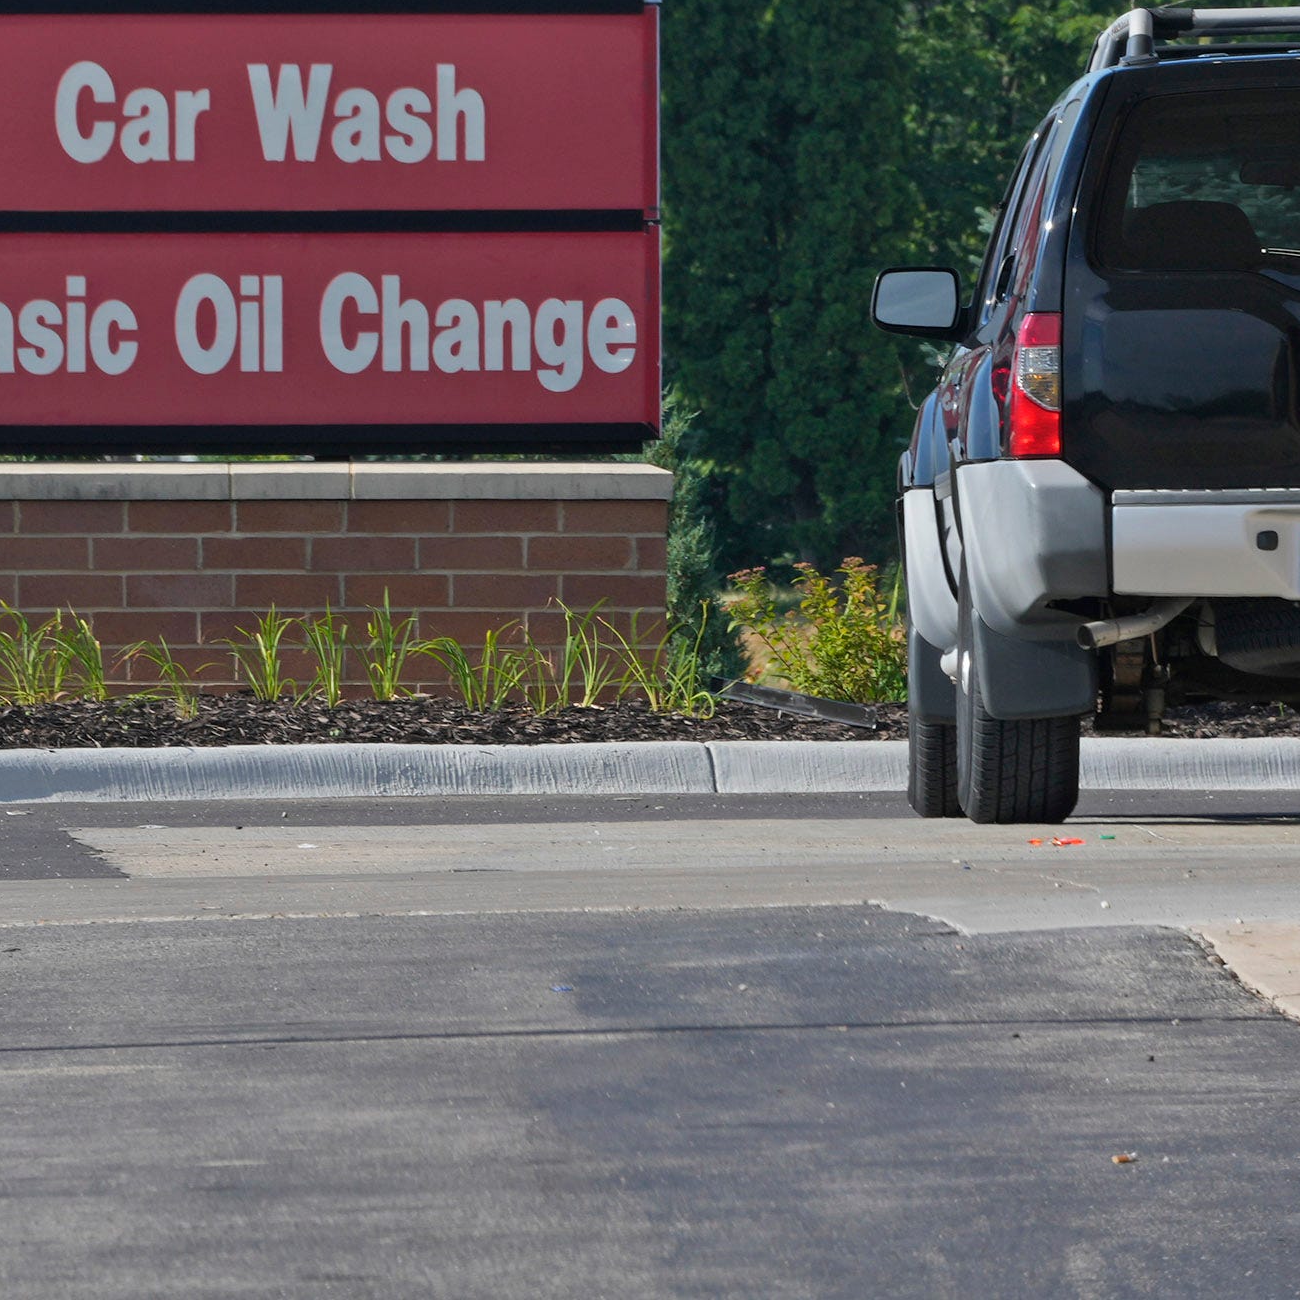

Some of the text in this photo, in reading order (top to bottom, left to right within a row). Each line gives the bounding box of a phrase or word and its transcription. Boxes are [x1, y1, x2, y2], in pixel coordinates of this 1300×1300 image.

[55, 61, 485, 164] Car Wash
[175, 273, 283, 375] Oil
[320, 272, 637, 392] Change
